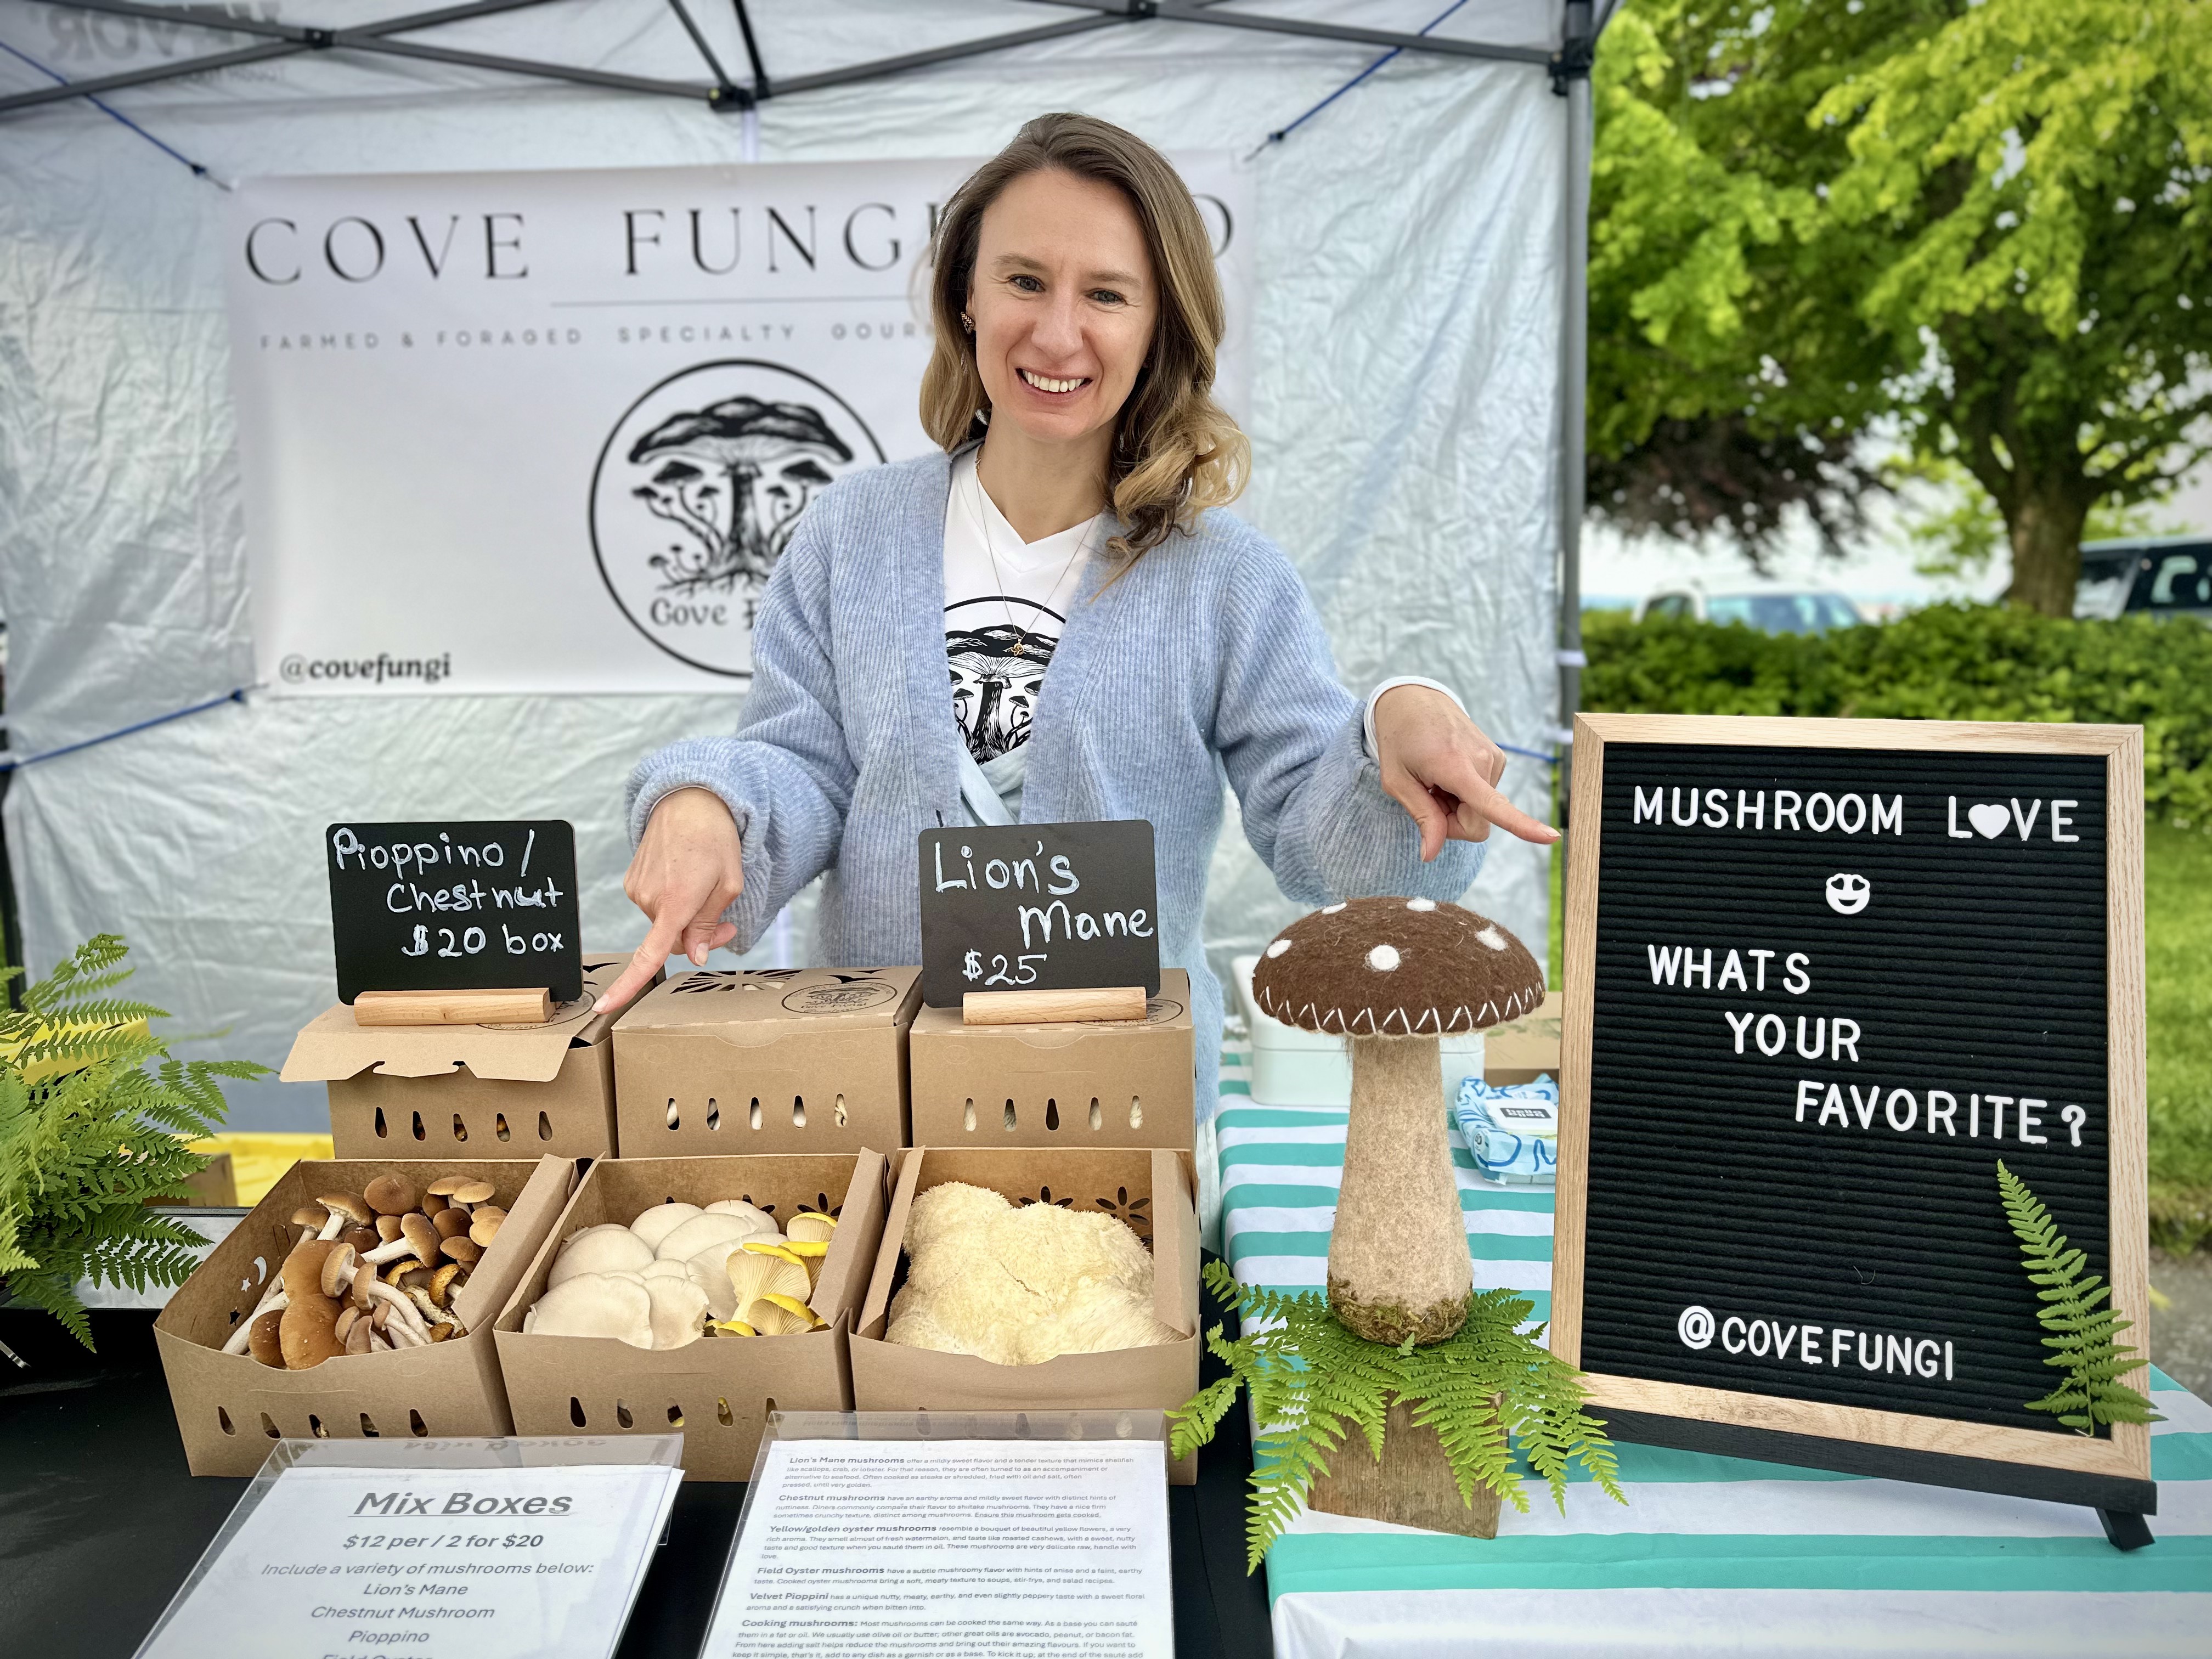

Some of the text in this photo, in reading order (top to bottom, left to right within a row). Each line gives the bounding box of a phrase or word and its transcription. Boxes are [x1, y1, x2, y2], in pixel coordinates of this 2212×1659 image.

[244, 214, 528, 285] COVE
[259, 323, 934, 351] FARMED & FORAGED SPECIALTY GOUR
[650, 597, 727, 627] Cove
[279, 652, 452, 684] @covefungi
[1634, 786, 1902, 835] MUSHROOM
[333, 827, 534, 880] Pioppino /
[935, 840, 1079, 895] Lion's
[387, 877, 563, 912] Chestnut
[1018, 900, 1154, 949] Mane
[402, 923, 563, 957] $20 box
[962, 946, 1047, 985] $25
[1647, 944, 1810, 994] WHATS
[1725, 1012, 1860, 1062] YOUR
[1678, 1306, 1953, 1380] @COVEFUNGI
[353, 1492, 573, 1514] Mix Boxes
[343, 1533, 544, 1550] $12 per / 2 for $20
[769, 1525, 841, 1534] Yellow/golden
[842, 1526, 875, 1534] oyster
[261, 1562, 594, 1577] Include a variety of mushrooms below:
[785, 1567, 821, 1576] Oyster
[363, 1583, 469, 1595] Lion's Mane
[785, 1592, 830, 1601] Pioppini
[994, 1592, 1022, 1600] slightly
[311, 1606, 495, 1618] Chestnut Mushroom
[795, 1604, 833, 1612] satisfying
[348, 1630, 430, 1645] Pioppino
[741, 1619, 788, 1629] Cooking
[788, 1619, 859, 1627] mushrooms:
